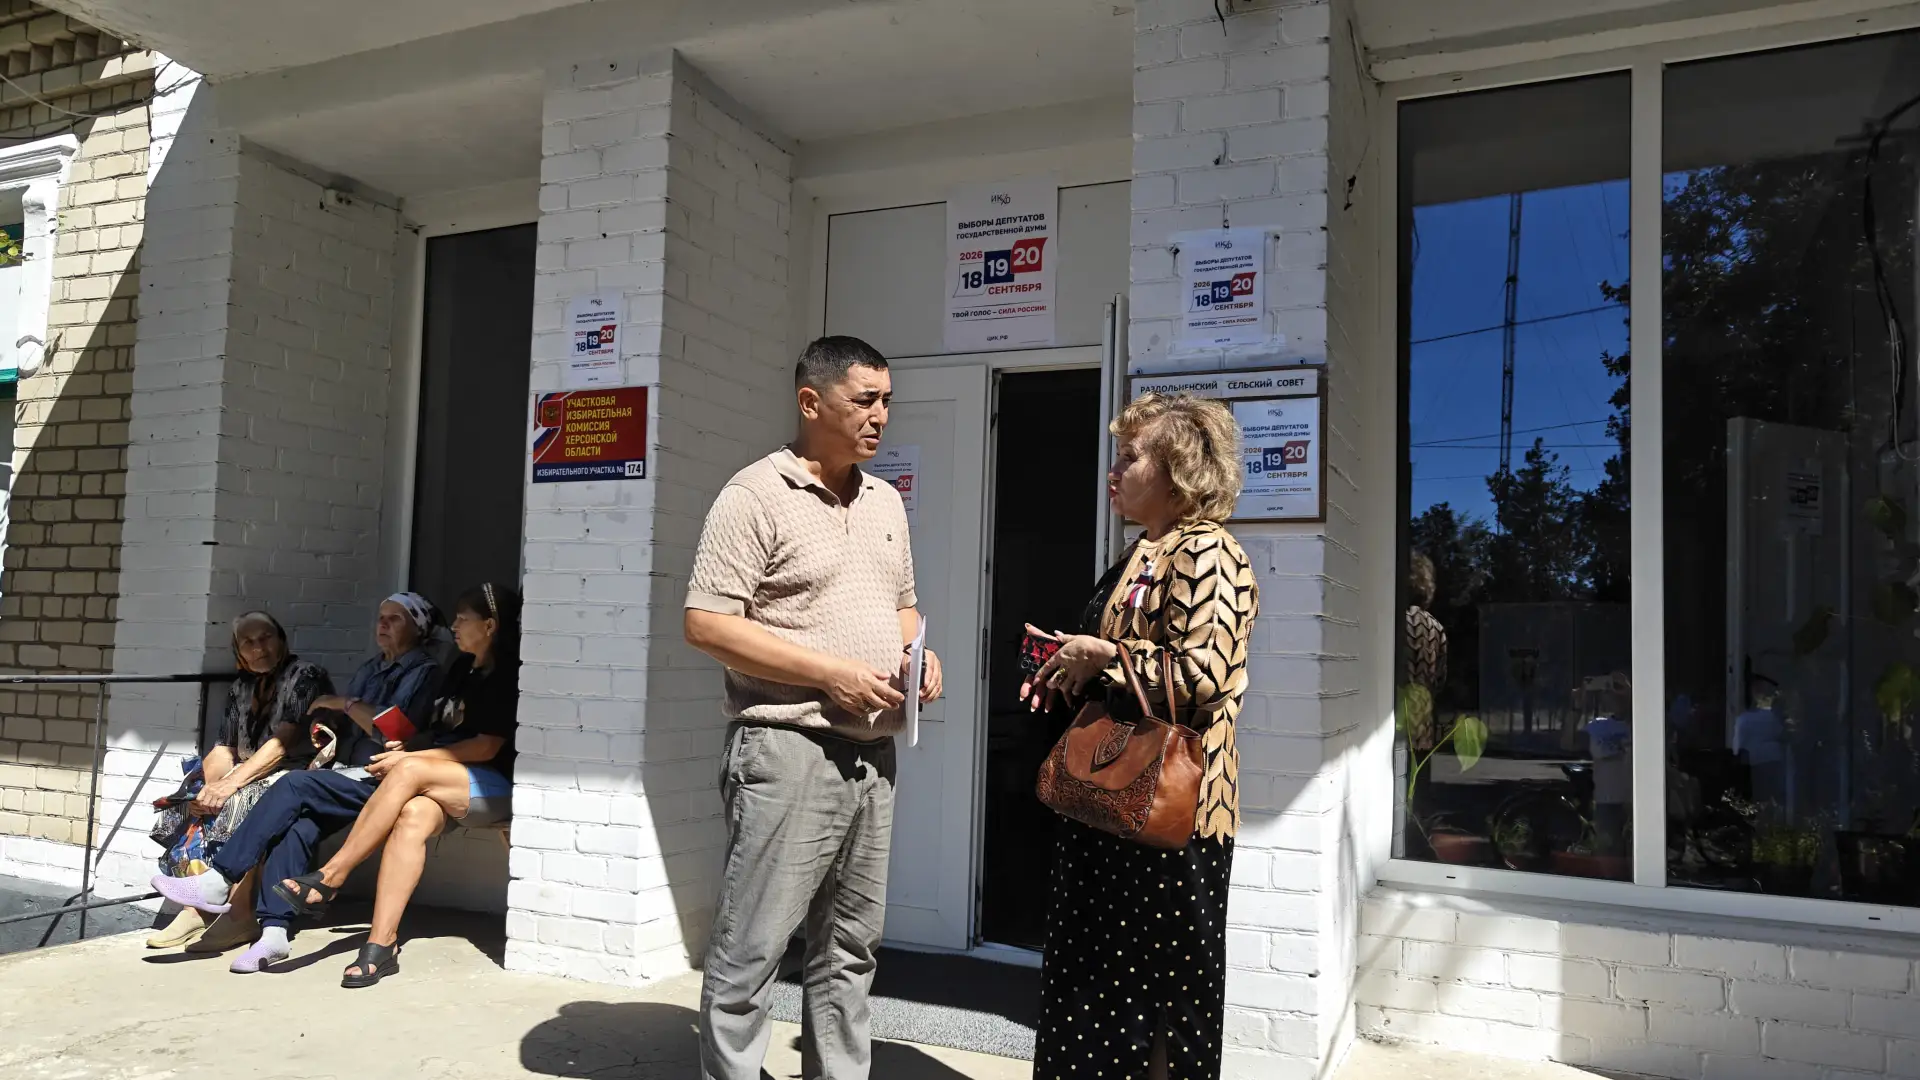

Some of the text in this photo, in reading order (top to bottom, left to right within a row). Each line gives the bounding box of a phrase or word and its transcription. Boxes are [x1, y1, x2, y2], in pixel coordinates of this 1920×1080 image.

[958, 213, 1045, 230] ВЫБОРЫ ДЕПУТАТОВ
[956, 224, 1047, 240] ГОСУДАРСТВЕННОЙ ДУМЫ
[960, 251, 983, 261] 2026
[1220, 255, 1252, 263] ДЕПУТАТОВ
[962, 246, 1039, 289] 18 19 20
[988, 283, 1042, 295] СЕНТЯБРЯ
[1195, 278, 1251, 307] 18 19 20
[1018, 305, 1046, 314] РОССИИ!
[1215, 302, 1254, 311] СЕНТЯБРЯ
[576, 330, 613, 352] 18 19 20
[1140, 378, 1304, 393] РАЗДОЛЬНЕНСКИЙ СЕЛЬСКИЙ СОВЕТ
[566, 396, 616, 408] УЧАСТКОВАЯ
[566, 407, 632, 420] ИЗБИРАТЕЛЬНАЯ
[566, 421, 610, 432] КОМИССИЯ
[565, 431, 617, 445] ХЕРСОНСКОЙ
[565, 445, 601, 457] ОБЛАСТИ
[1246, 446, 1305, 474] 18 19 20
[537, 468, 588, 477] ИЗБИРАТЕЛЬНОГО
[589, 466, 615, 475] УЧАСТКА
[626, 464, 641, 474] 174
[898, 479, 910, 488] 20
